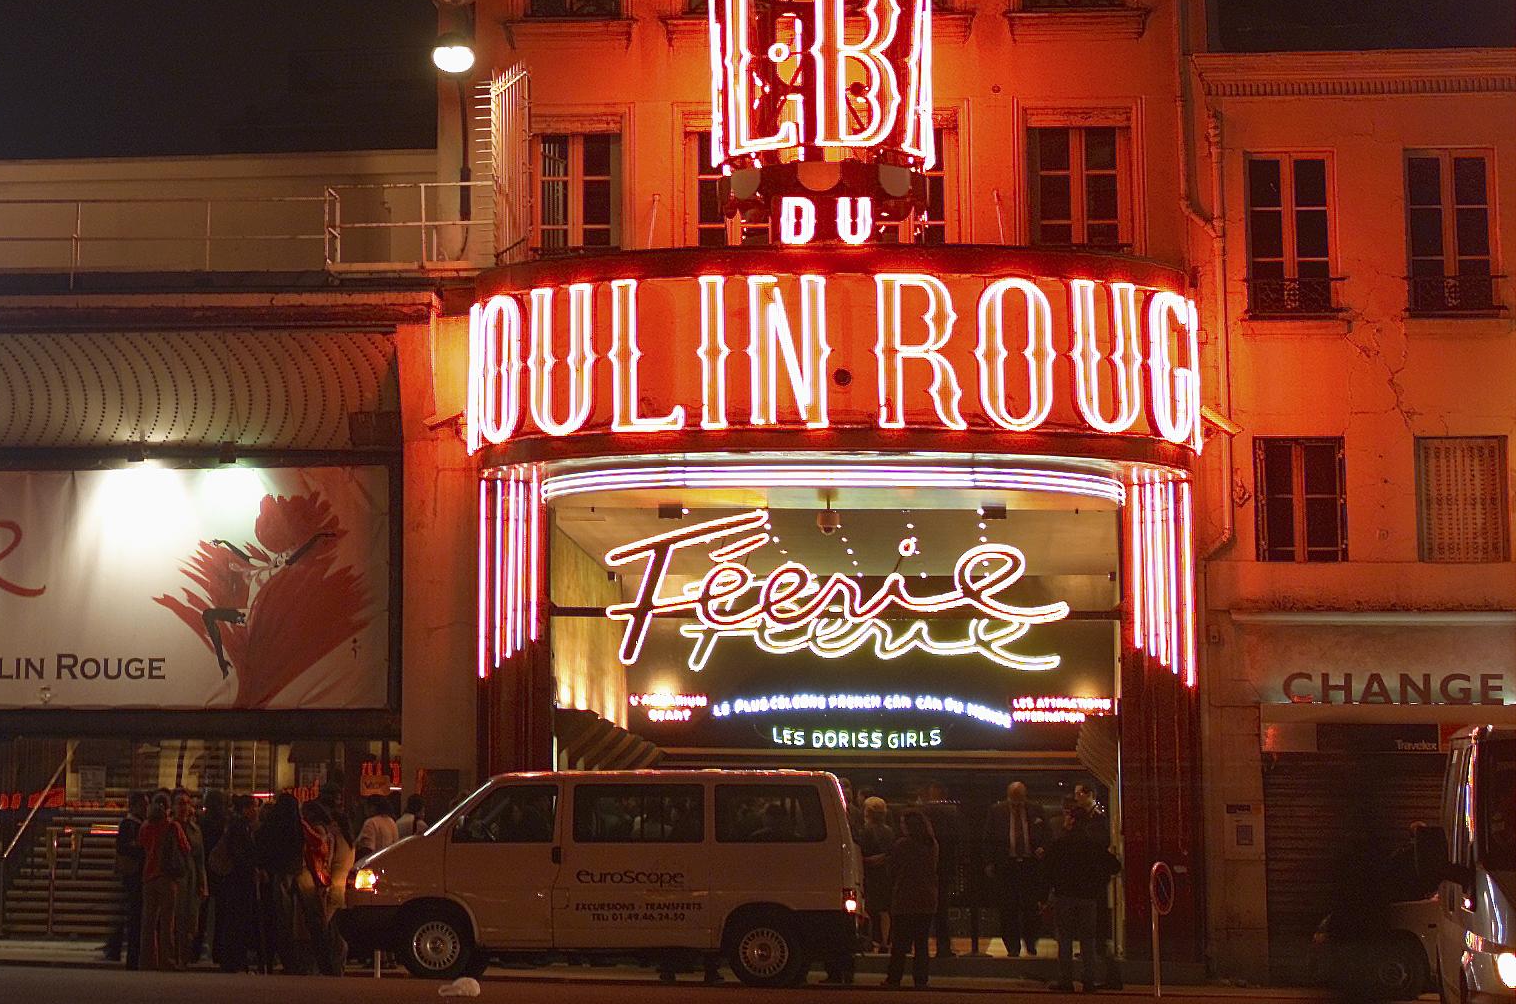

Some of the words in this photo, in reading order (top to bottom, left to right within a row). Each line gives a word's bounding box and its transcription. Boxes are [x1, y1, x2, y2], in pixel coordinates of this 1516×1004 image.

[780, 196, 873, 245] DU
[605, 509, 1071, 665] Féerie
[55, 653, 167, 681] ROUGE
[1282, 671, 1505, 706] CHANGE
[772, 727, 805, 746] LES
[812, 729, 883, 749] DORISS
[887, 728, 942, 749] GIRLS
[1395, 738, 1438, 751] Travelex
